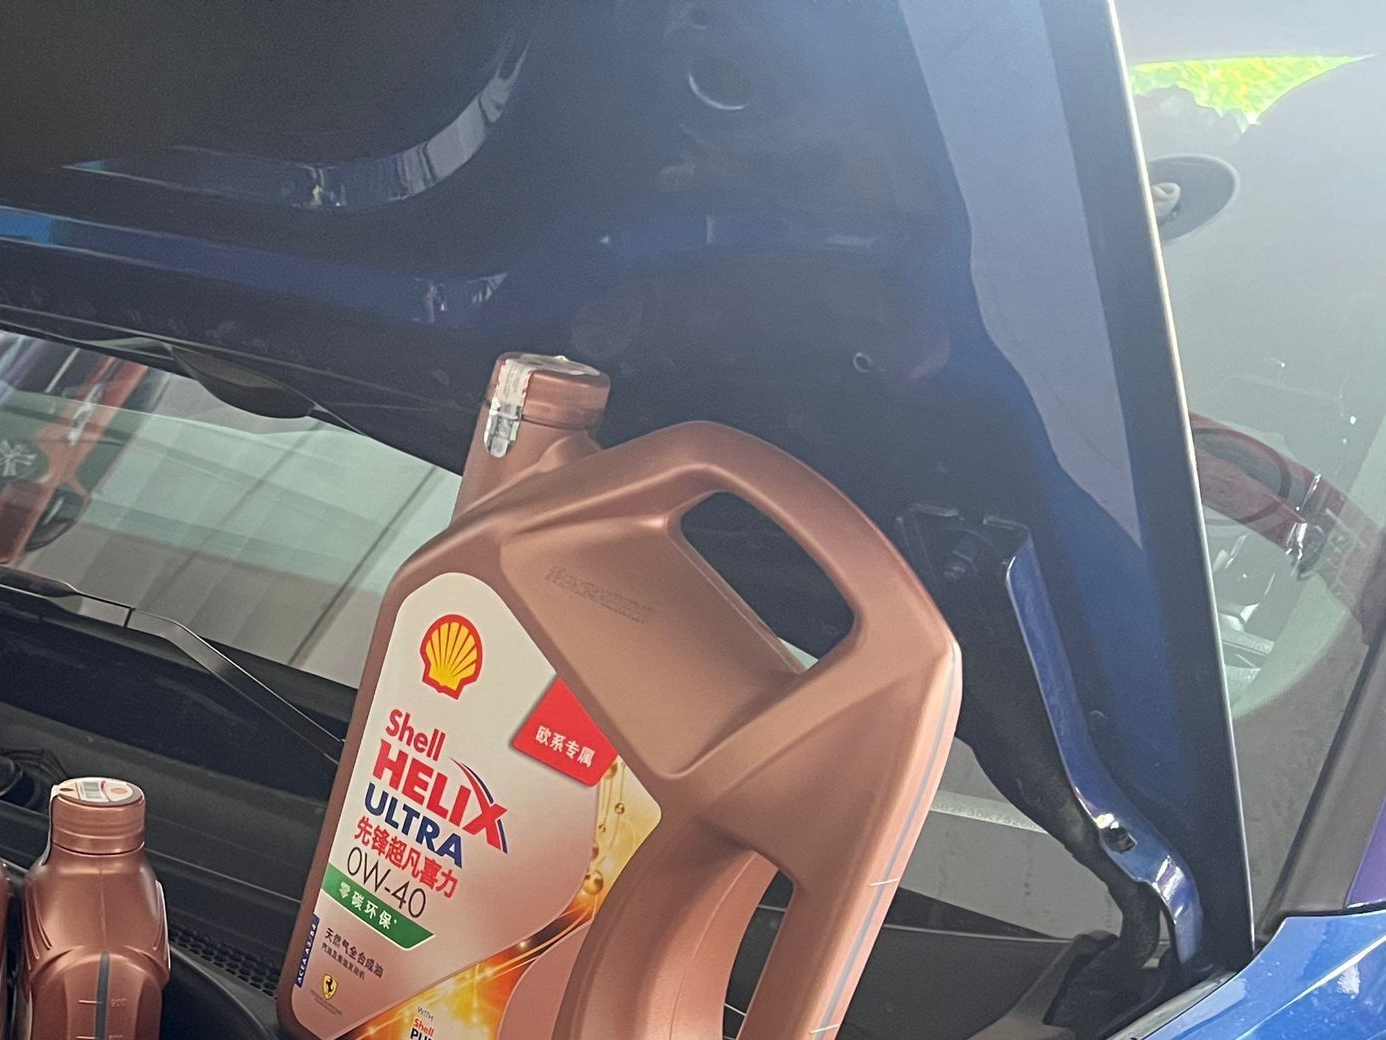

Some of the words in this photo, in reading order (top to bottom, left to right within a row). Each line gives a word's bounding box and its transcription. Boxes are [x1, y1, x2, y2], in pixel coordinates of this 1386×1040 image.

[385, 708, 446, 762] Shell
[535, 725, 597, 768] 欧系专属
[372, 738, 508, 851] HELIX
[365, 782, 462, 868] ULTRA
[347, 846, 426, 918] 0W-40
[354, 815, 459, 900] 先锋超凡喜力
[297, 957, 307, 984] ACEA
[325, 927, 384, 979] 天然气全合成油
[414, 1018, 435, 1037] Shell
[417, 1006, 434, 1022] WITH
